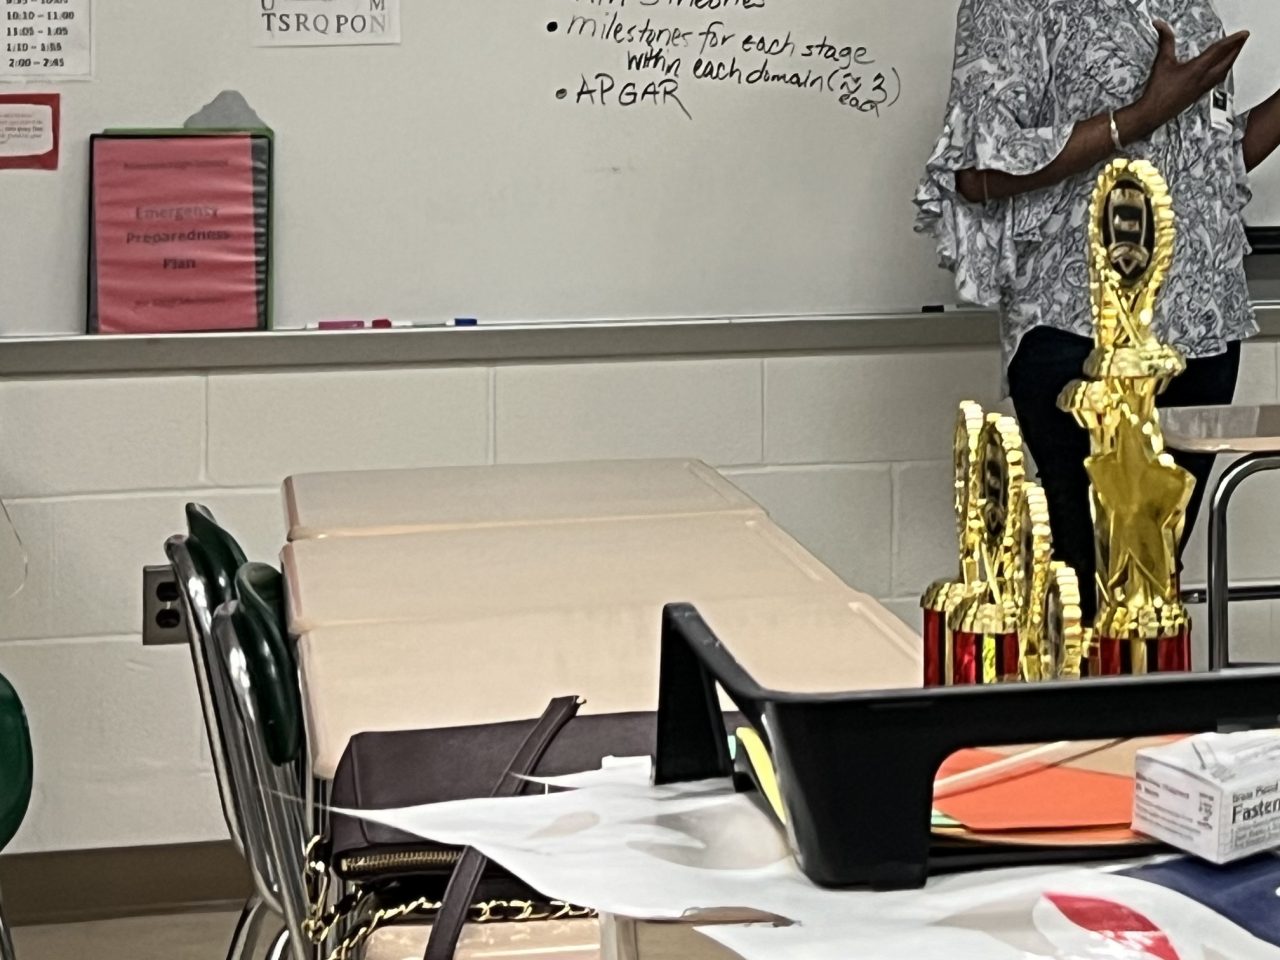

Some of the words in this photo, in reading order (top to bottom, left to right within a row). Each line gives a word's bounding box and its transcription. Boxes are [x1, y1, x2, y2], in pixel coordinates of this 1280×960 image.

[699, 21, 737, 54] for
[742, 32, 795, 58] each
[800, 36, 876, 68] stage
[692, 54, 744, 84] each
[746, 59, 825, 91] domain
[576, 72, 692, 122] APGAR
[126, 228, 231, 244] Preparedness
